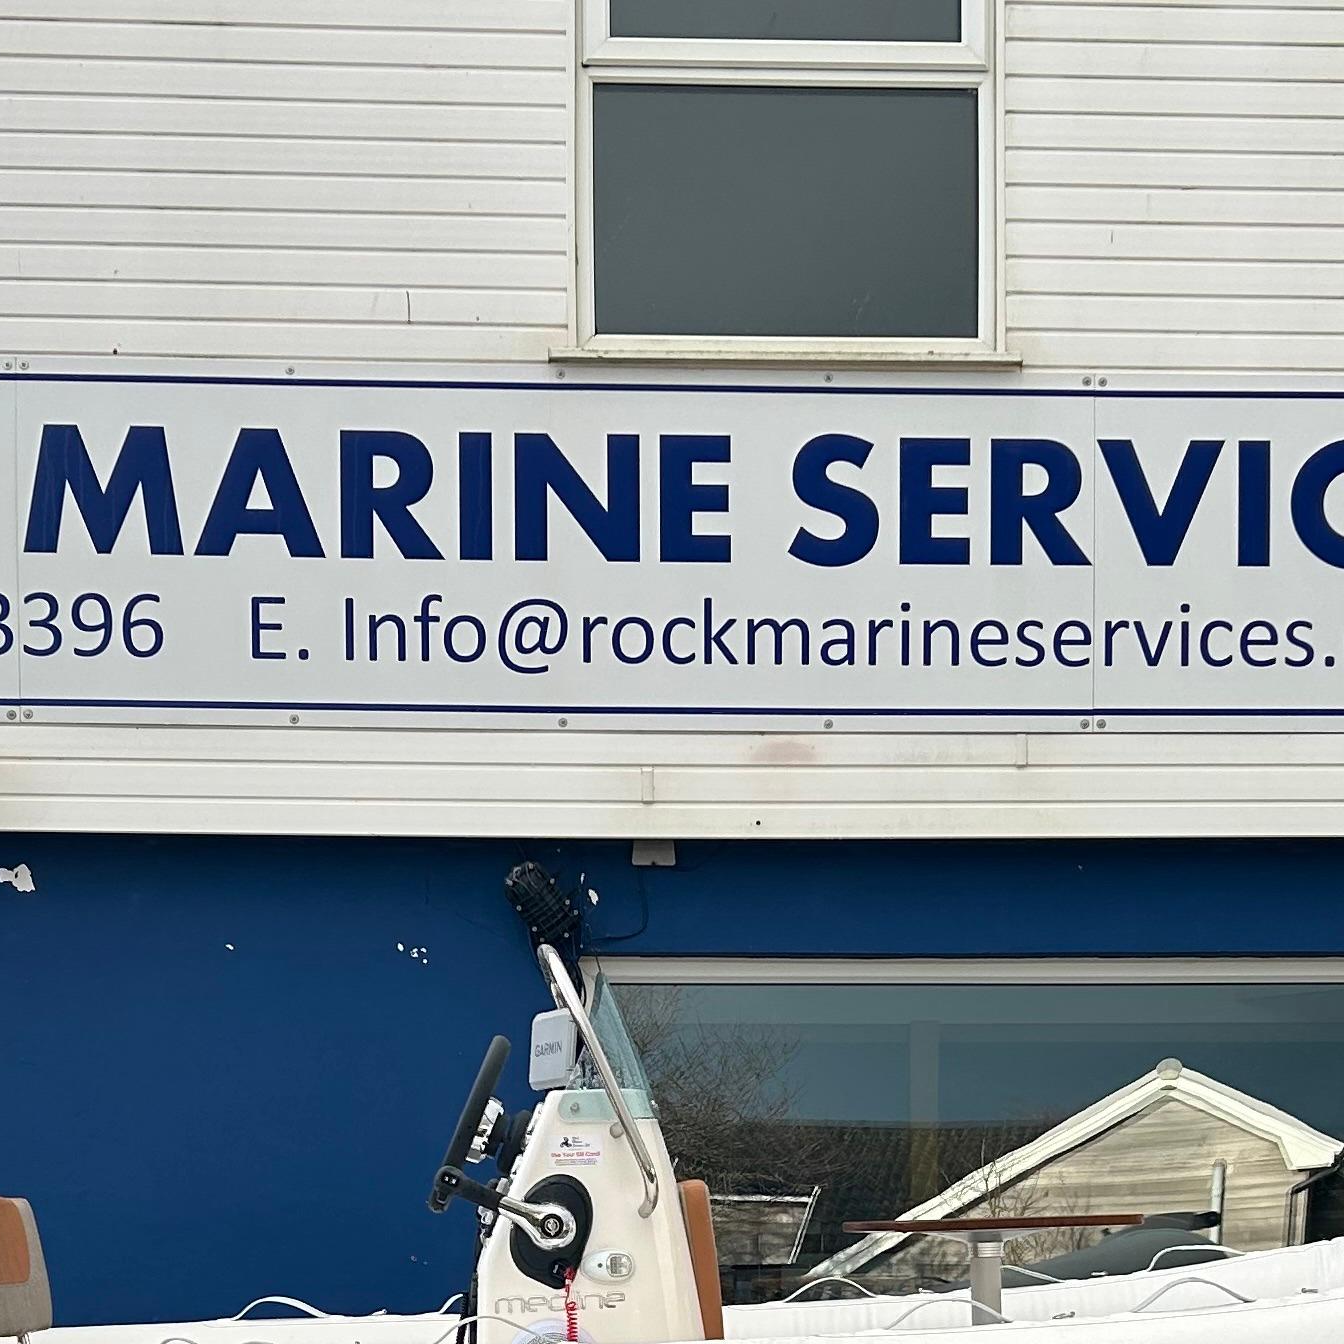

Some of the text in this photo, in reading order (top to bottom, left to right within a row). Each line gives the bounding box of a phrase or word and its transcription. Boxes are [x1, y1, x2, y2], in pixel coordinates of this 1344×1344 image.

[24, 424, 731, 563] MARINE
[252, 597, 308, 660] E.
[535, 1041, 562, 1058] GARMIN
